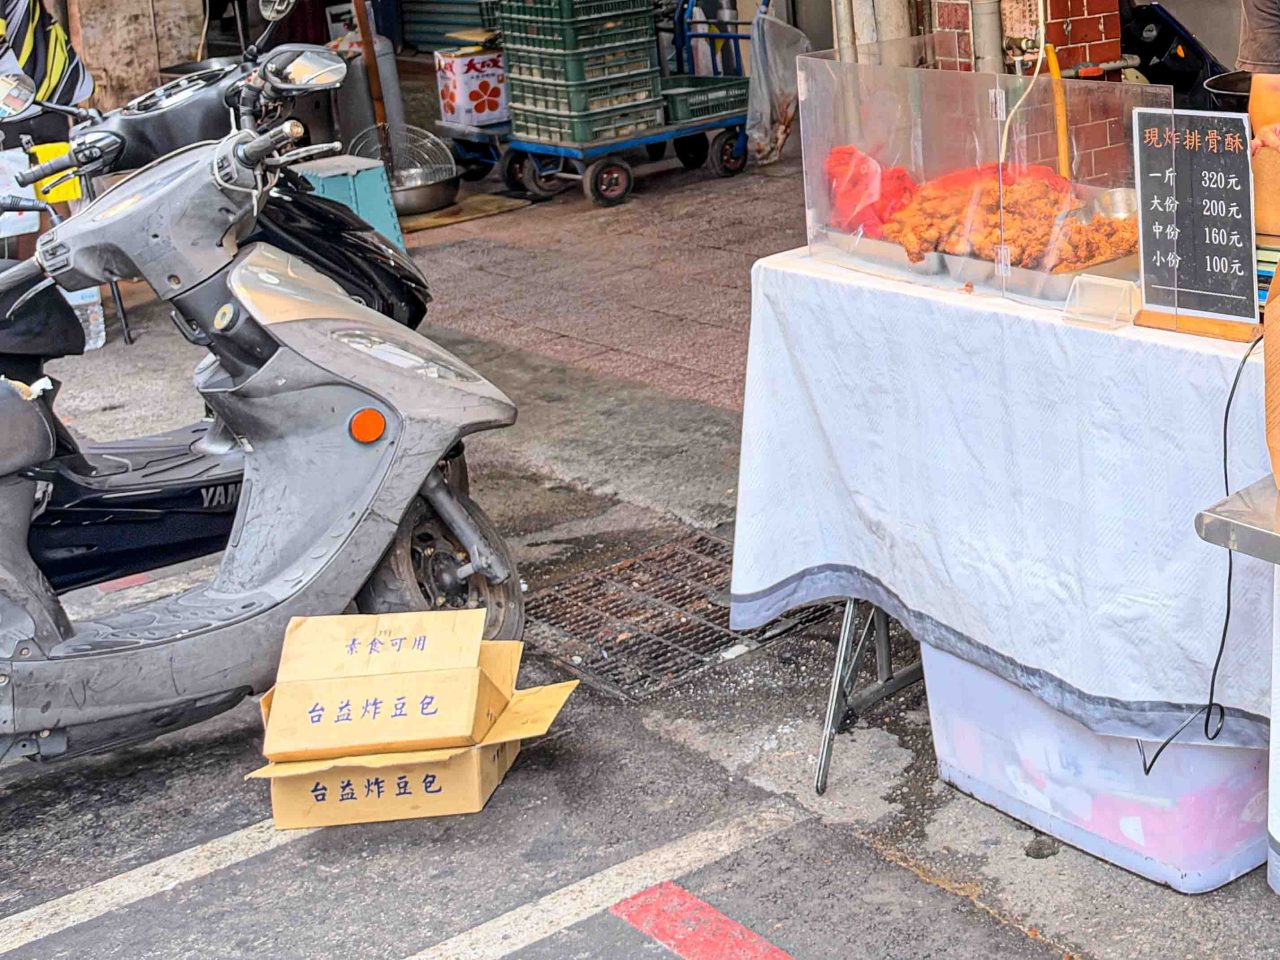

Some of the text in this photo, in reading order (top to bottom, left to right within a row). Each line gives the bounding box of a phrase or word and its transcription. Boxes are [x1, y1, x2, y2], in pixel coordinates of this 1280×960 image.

[1143, 127, 1244, 154] 現炸排骨酥
[1148, 167, 1241, 190] 一斤 320元
[1150, 195, 1242, 218] 大份 200元
[1152, 221, 1243, 247] 中份 160元
[1152, 250, 1244, 276] 小份 100元
[345, 635, 427, 655] 素食可用
[308, 694, 439, 725] 台益炸豆包
[309, 773, 443, 803] 台益炸豆包
